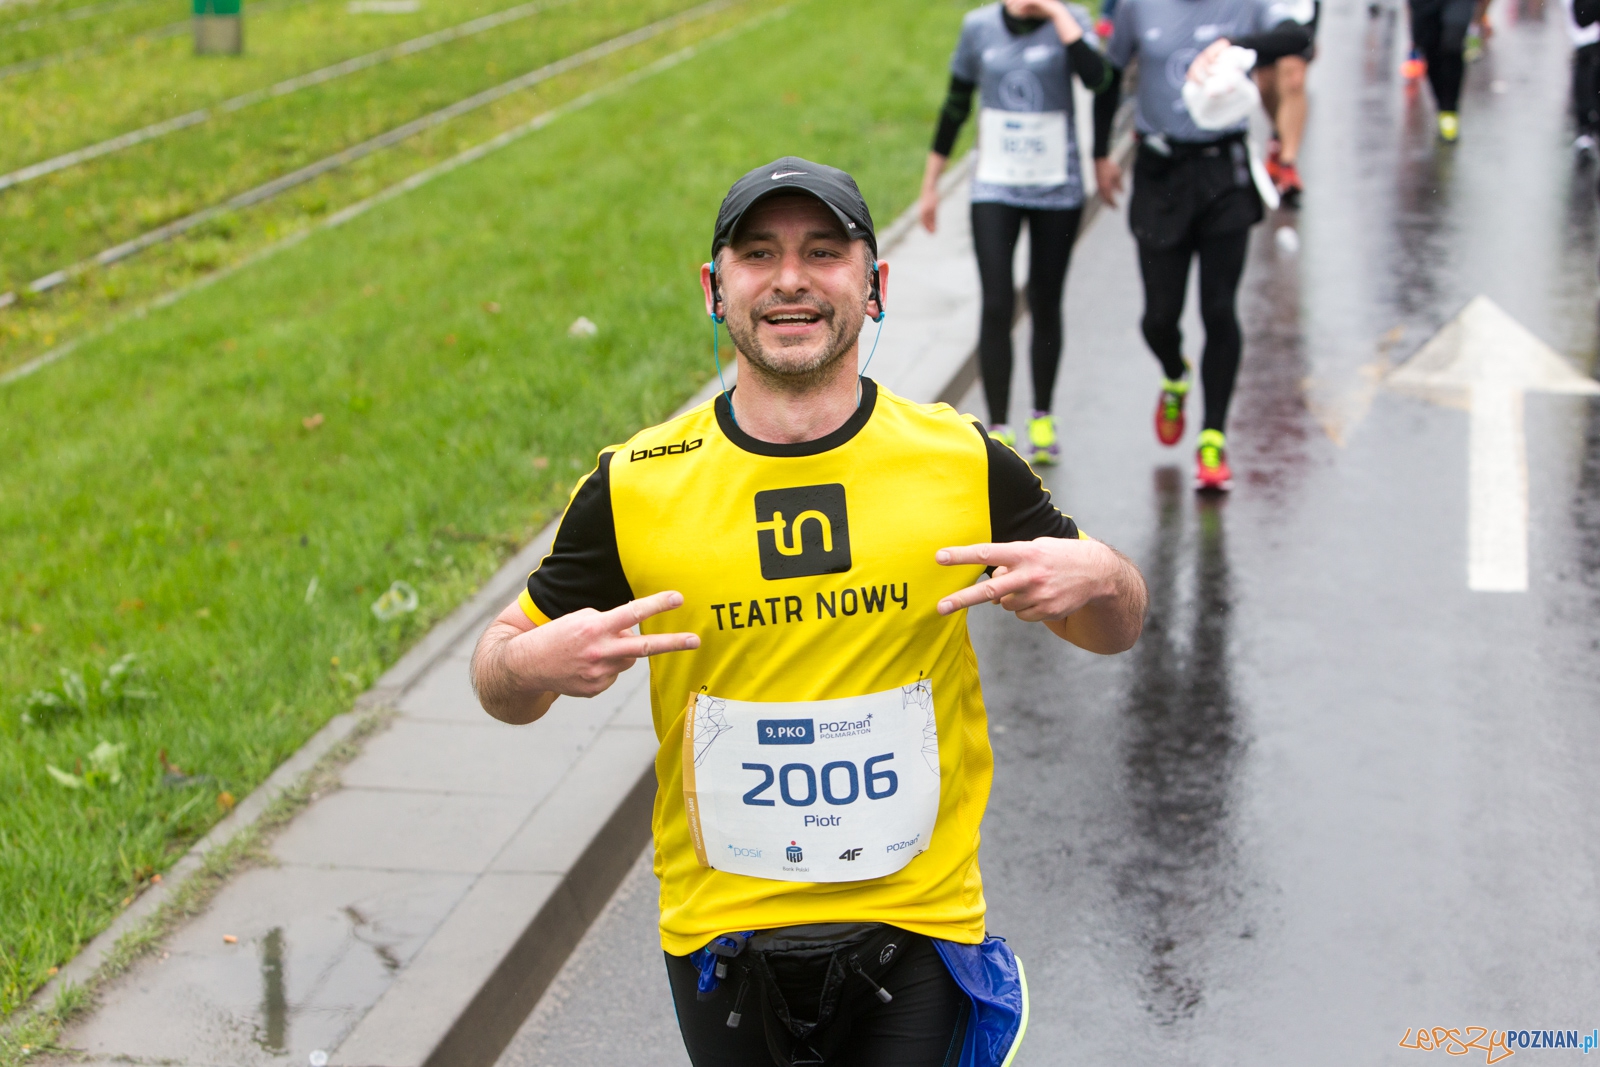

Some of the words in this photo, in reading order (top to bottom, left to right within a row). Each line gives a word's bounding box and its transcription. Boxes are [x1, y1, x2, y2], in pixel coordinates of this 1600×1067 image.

[711, 595, 804, 631] TEATR
[741, 752, 899, 808] 2006
[804, 814, 842, 827] Piotr
[838, 847, 864, 861] 4F
